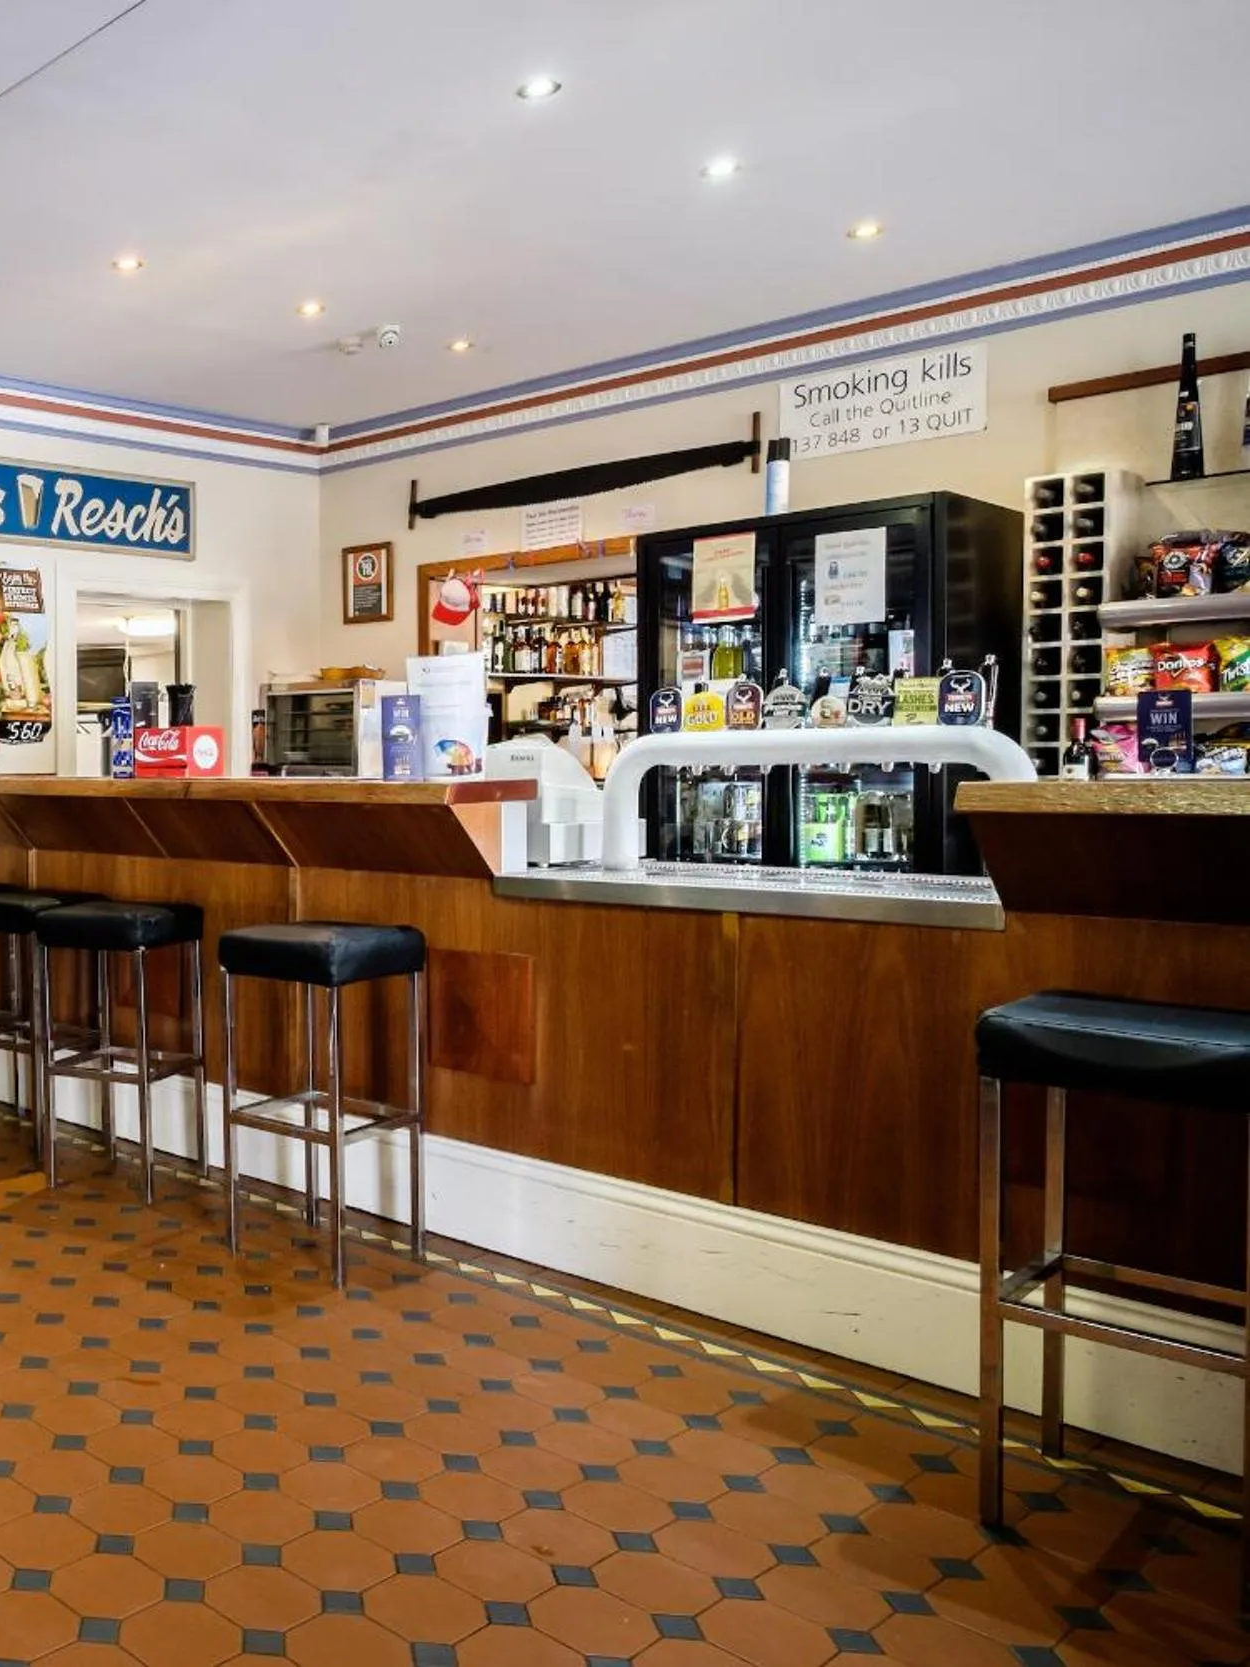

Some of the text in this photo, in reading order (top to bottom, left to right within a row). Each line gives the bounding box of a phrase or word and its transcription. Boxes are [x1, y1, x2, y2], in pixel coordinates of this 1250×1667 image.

[794, 351, 972, 409] Smoking kills
[809, 389, 953, 428] Call the Quitline
[792, 408, 974, 453] 137 848 or 13 QUIT
[50, 478, 188, 546] Resch's
[1157, 653, 1205, 671] Doritos
[848, 699, 892, 715] DRY
[944, 703, 976, 713] NEW
[655, 714, 677, 724] NEW
[733, 711, 755, 721] OLD
[1150, 711, 1178, 724] WIN
